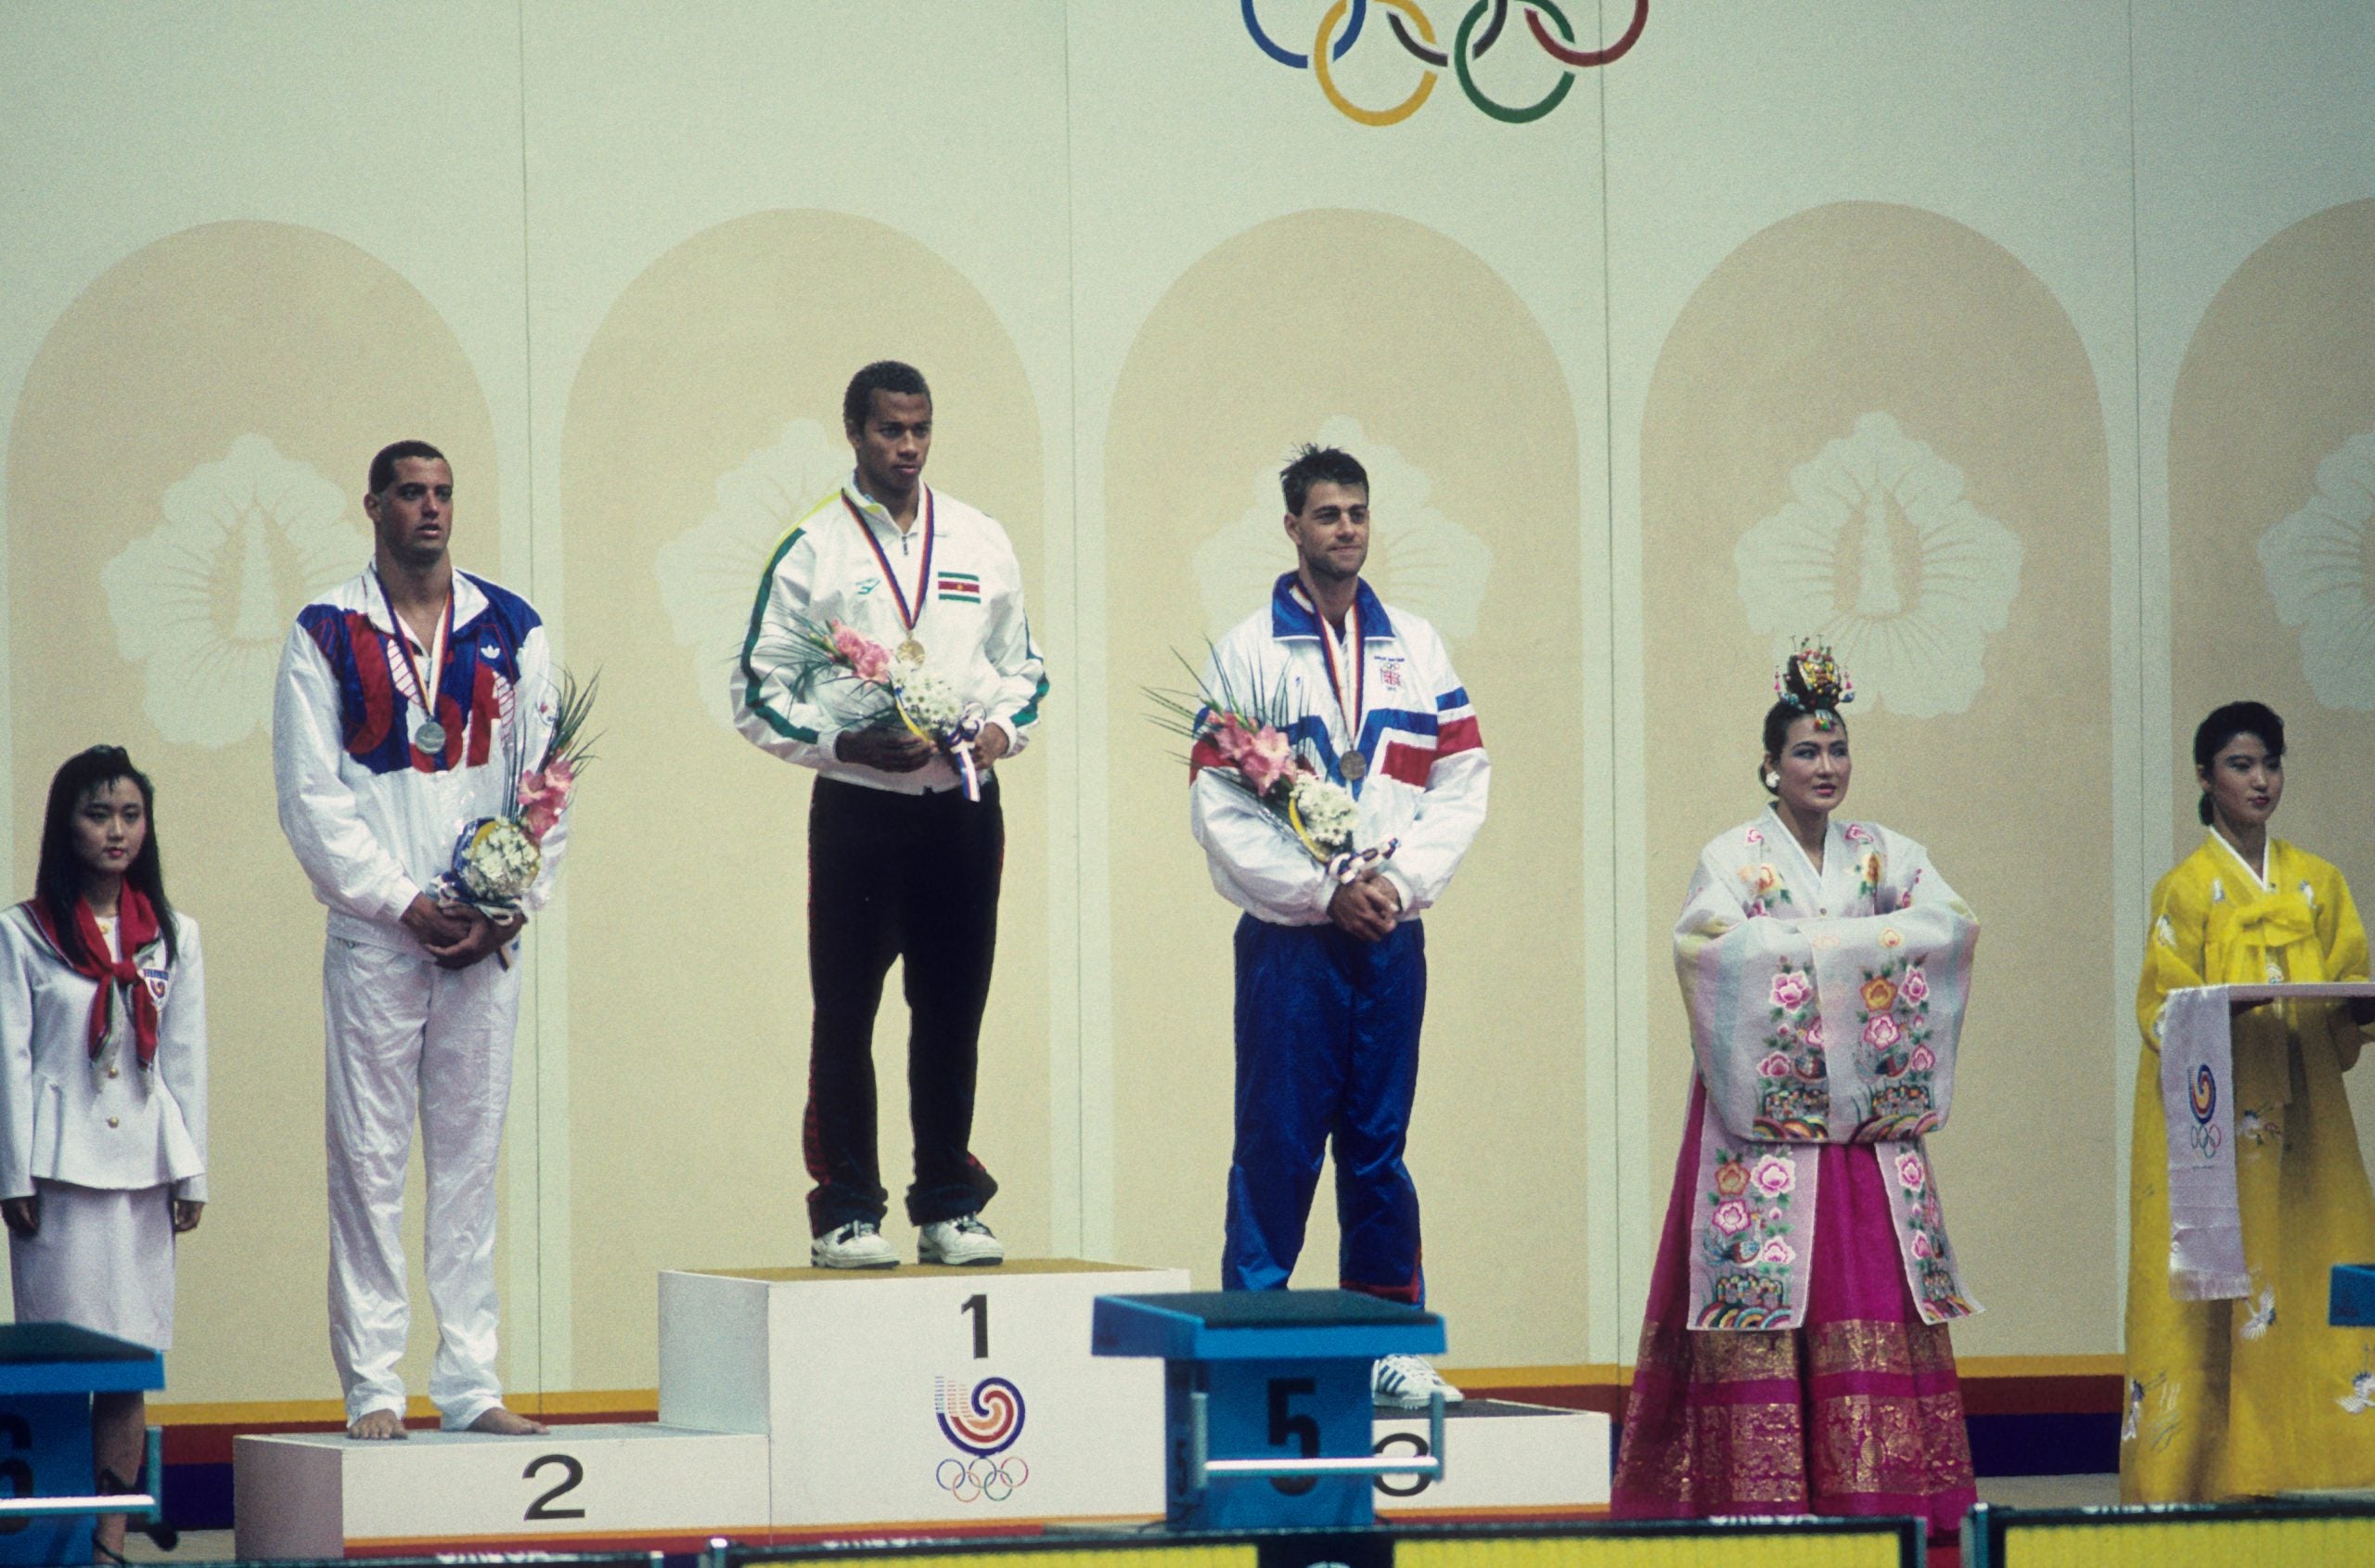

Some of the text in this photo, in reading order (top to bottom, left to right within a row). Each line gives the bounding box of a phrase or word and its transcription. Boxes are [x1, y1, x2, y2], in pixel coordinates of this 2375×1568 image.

[961, 1294, 989, 1359] 1
[1267, 1378, 1321, 1497] 5
[522, 1454, 585, 1521] 2
